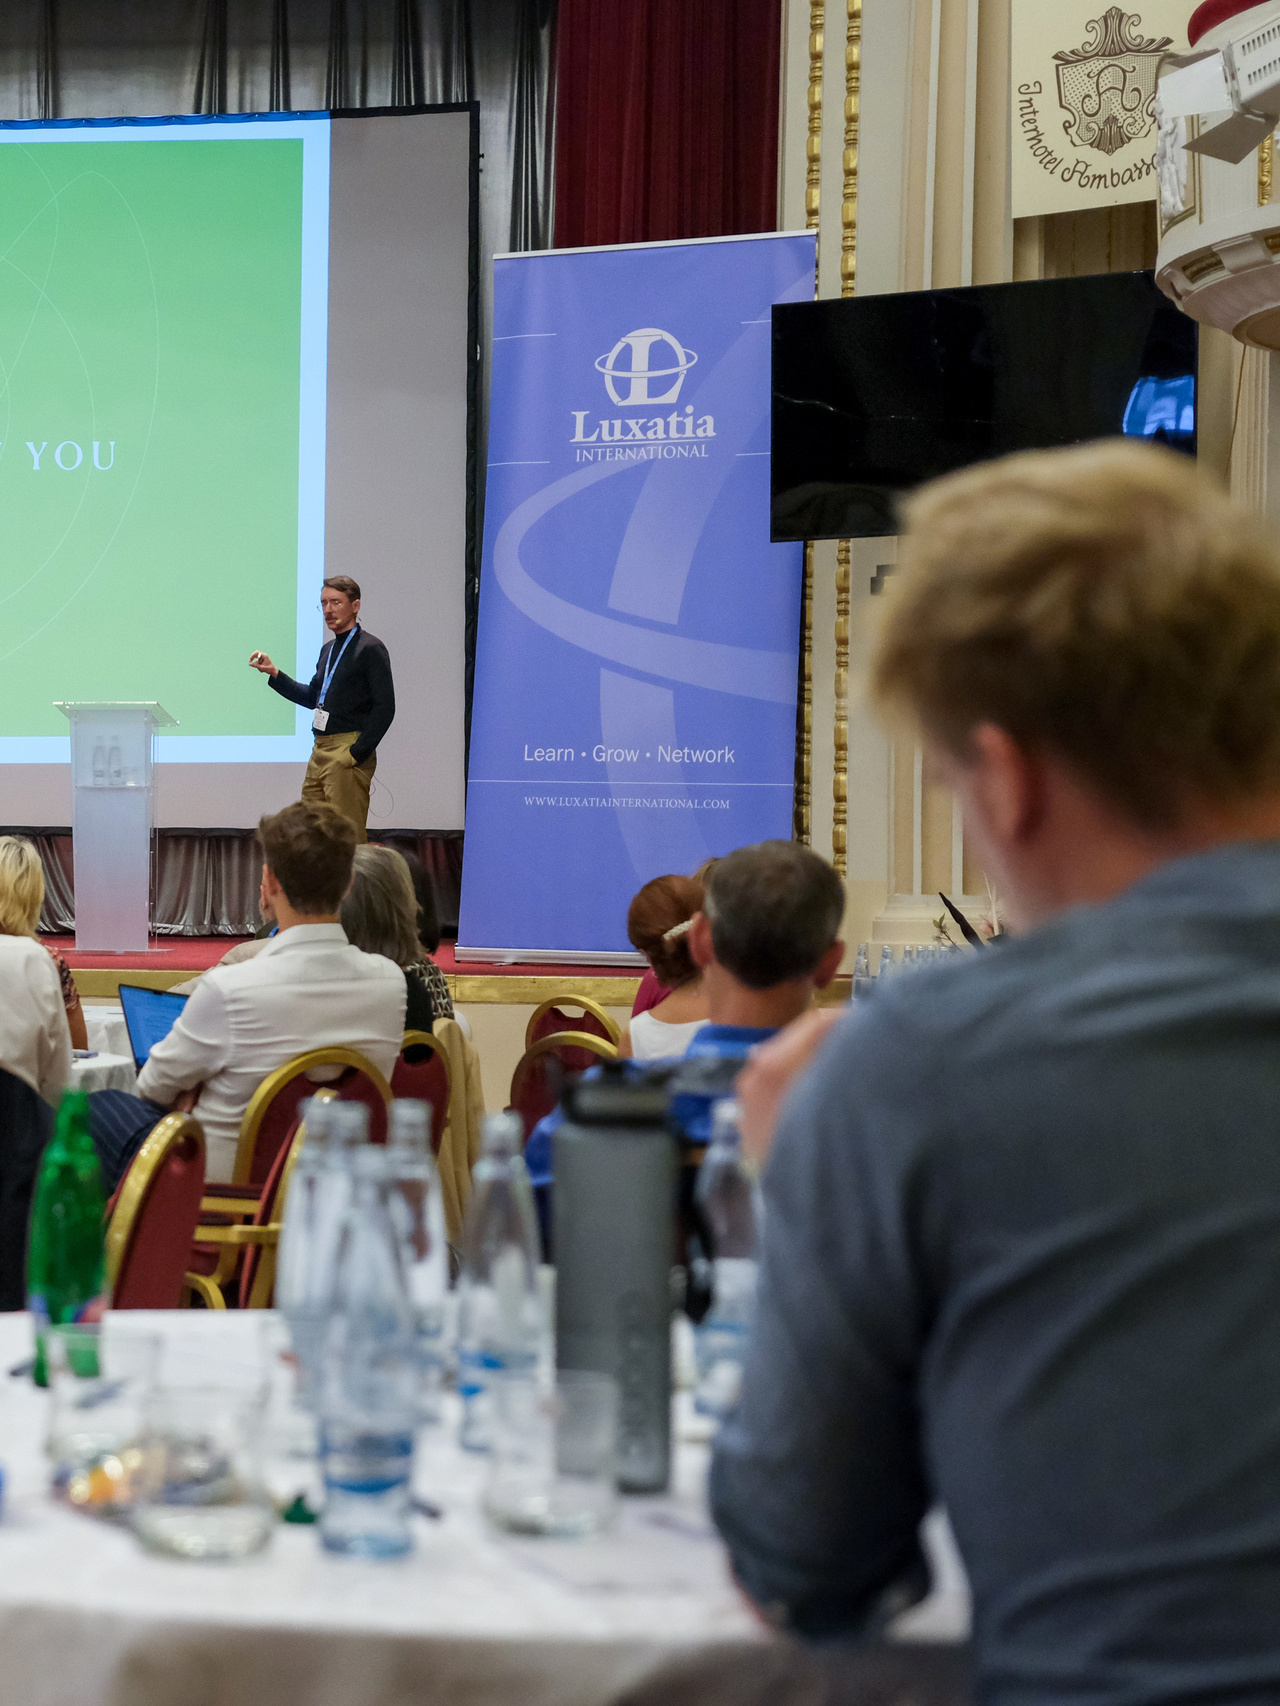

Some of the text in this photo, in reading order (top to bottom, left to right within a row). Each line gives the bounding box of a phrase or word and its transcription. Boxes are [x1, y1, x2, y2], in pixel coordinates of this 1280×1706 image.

[1018, 80, 1064, 174] Interhotel
[570, 405, 717, 442] Luxatia
[25, 440, 116, 470] YOU
[576, 445, 709, 462] INTERNATIONAL
[524, 744, 735, 763] Learn Grow Network
[524, 796, 730, 809] WWW.LUXATIAINTERNATIONAL.COM
